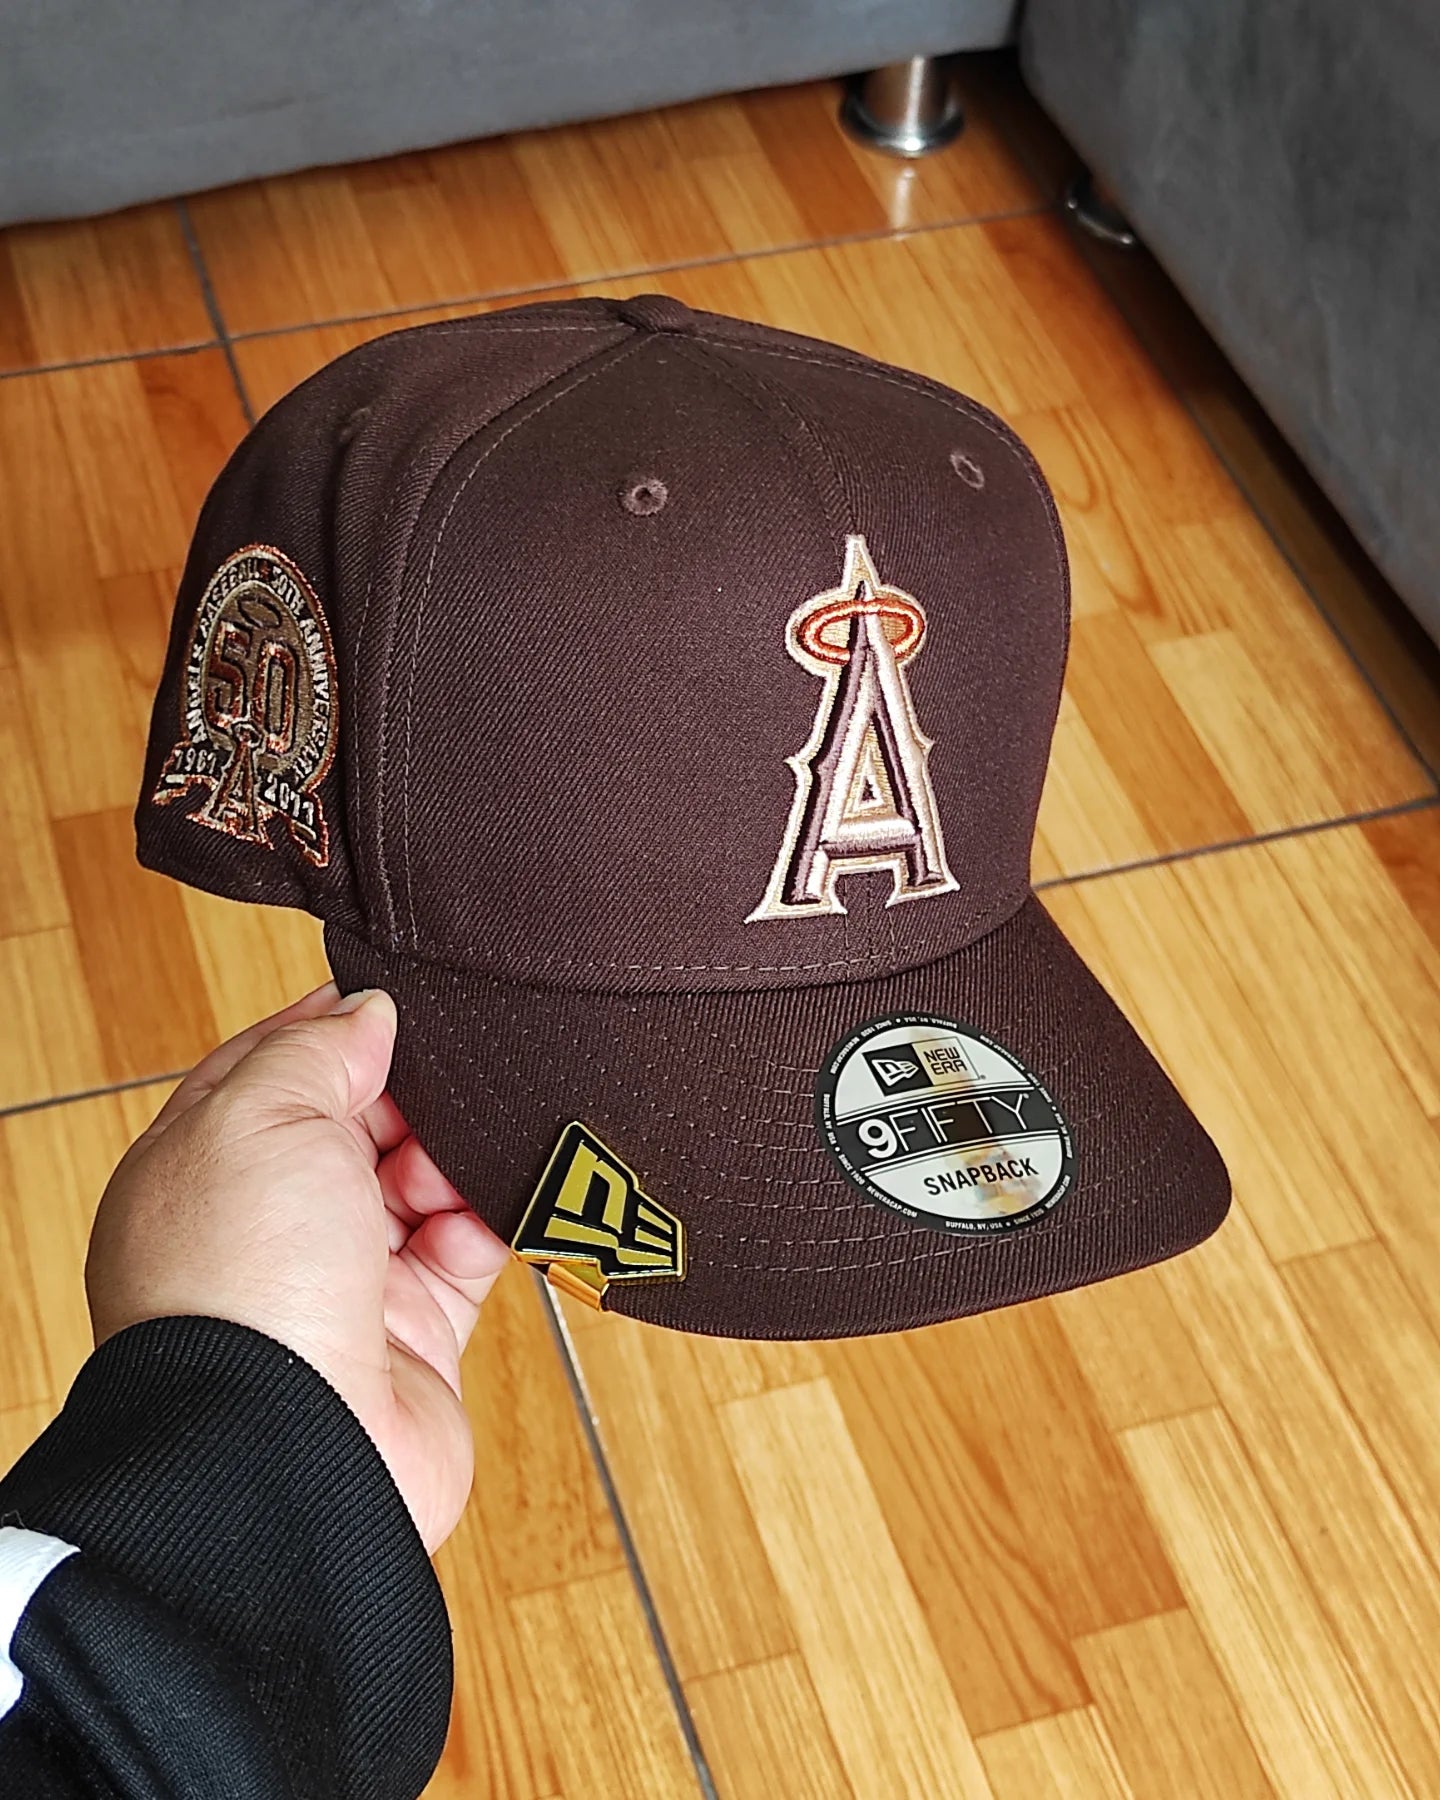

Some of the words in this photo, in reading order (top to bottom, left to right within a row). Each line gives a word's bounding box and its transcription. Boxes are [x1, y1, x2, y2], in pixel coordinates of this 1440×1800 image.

[206, 620, 298, 753] 50
[744, 533, 961, 925] A
[174, 748, 217, 775] 1961
[265, 772, 314, 827] 2011
[923, 1046, 960, 1063] NEW
[930, 1060, 968, 1075] ERA
[858, 1093, 1028, 1159] 9FIFTY
[923, 1157, 1040, 1196] SNAPBACK
